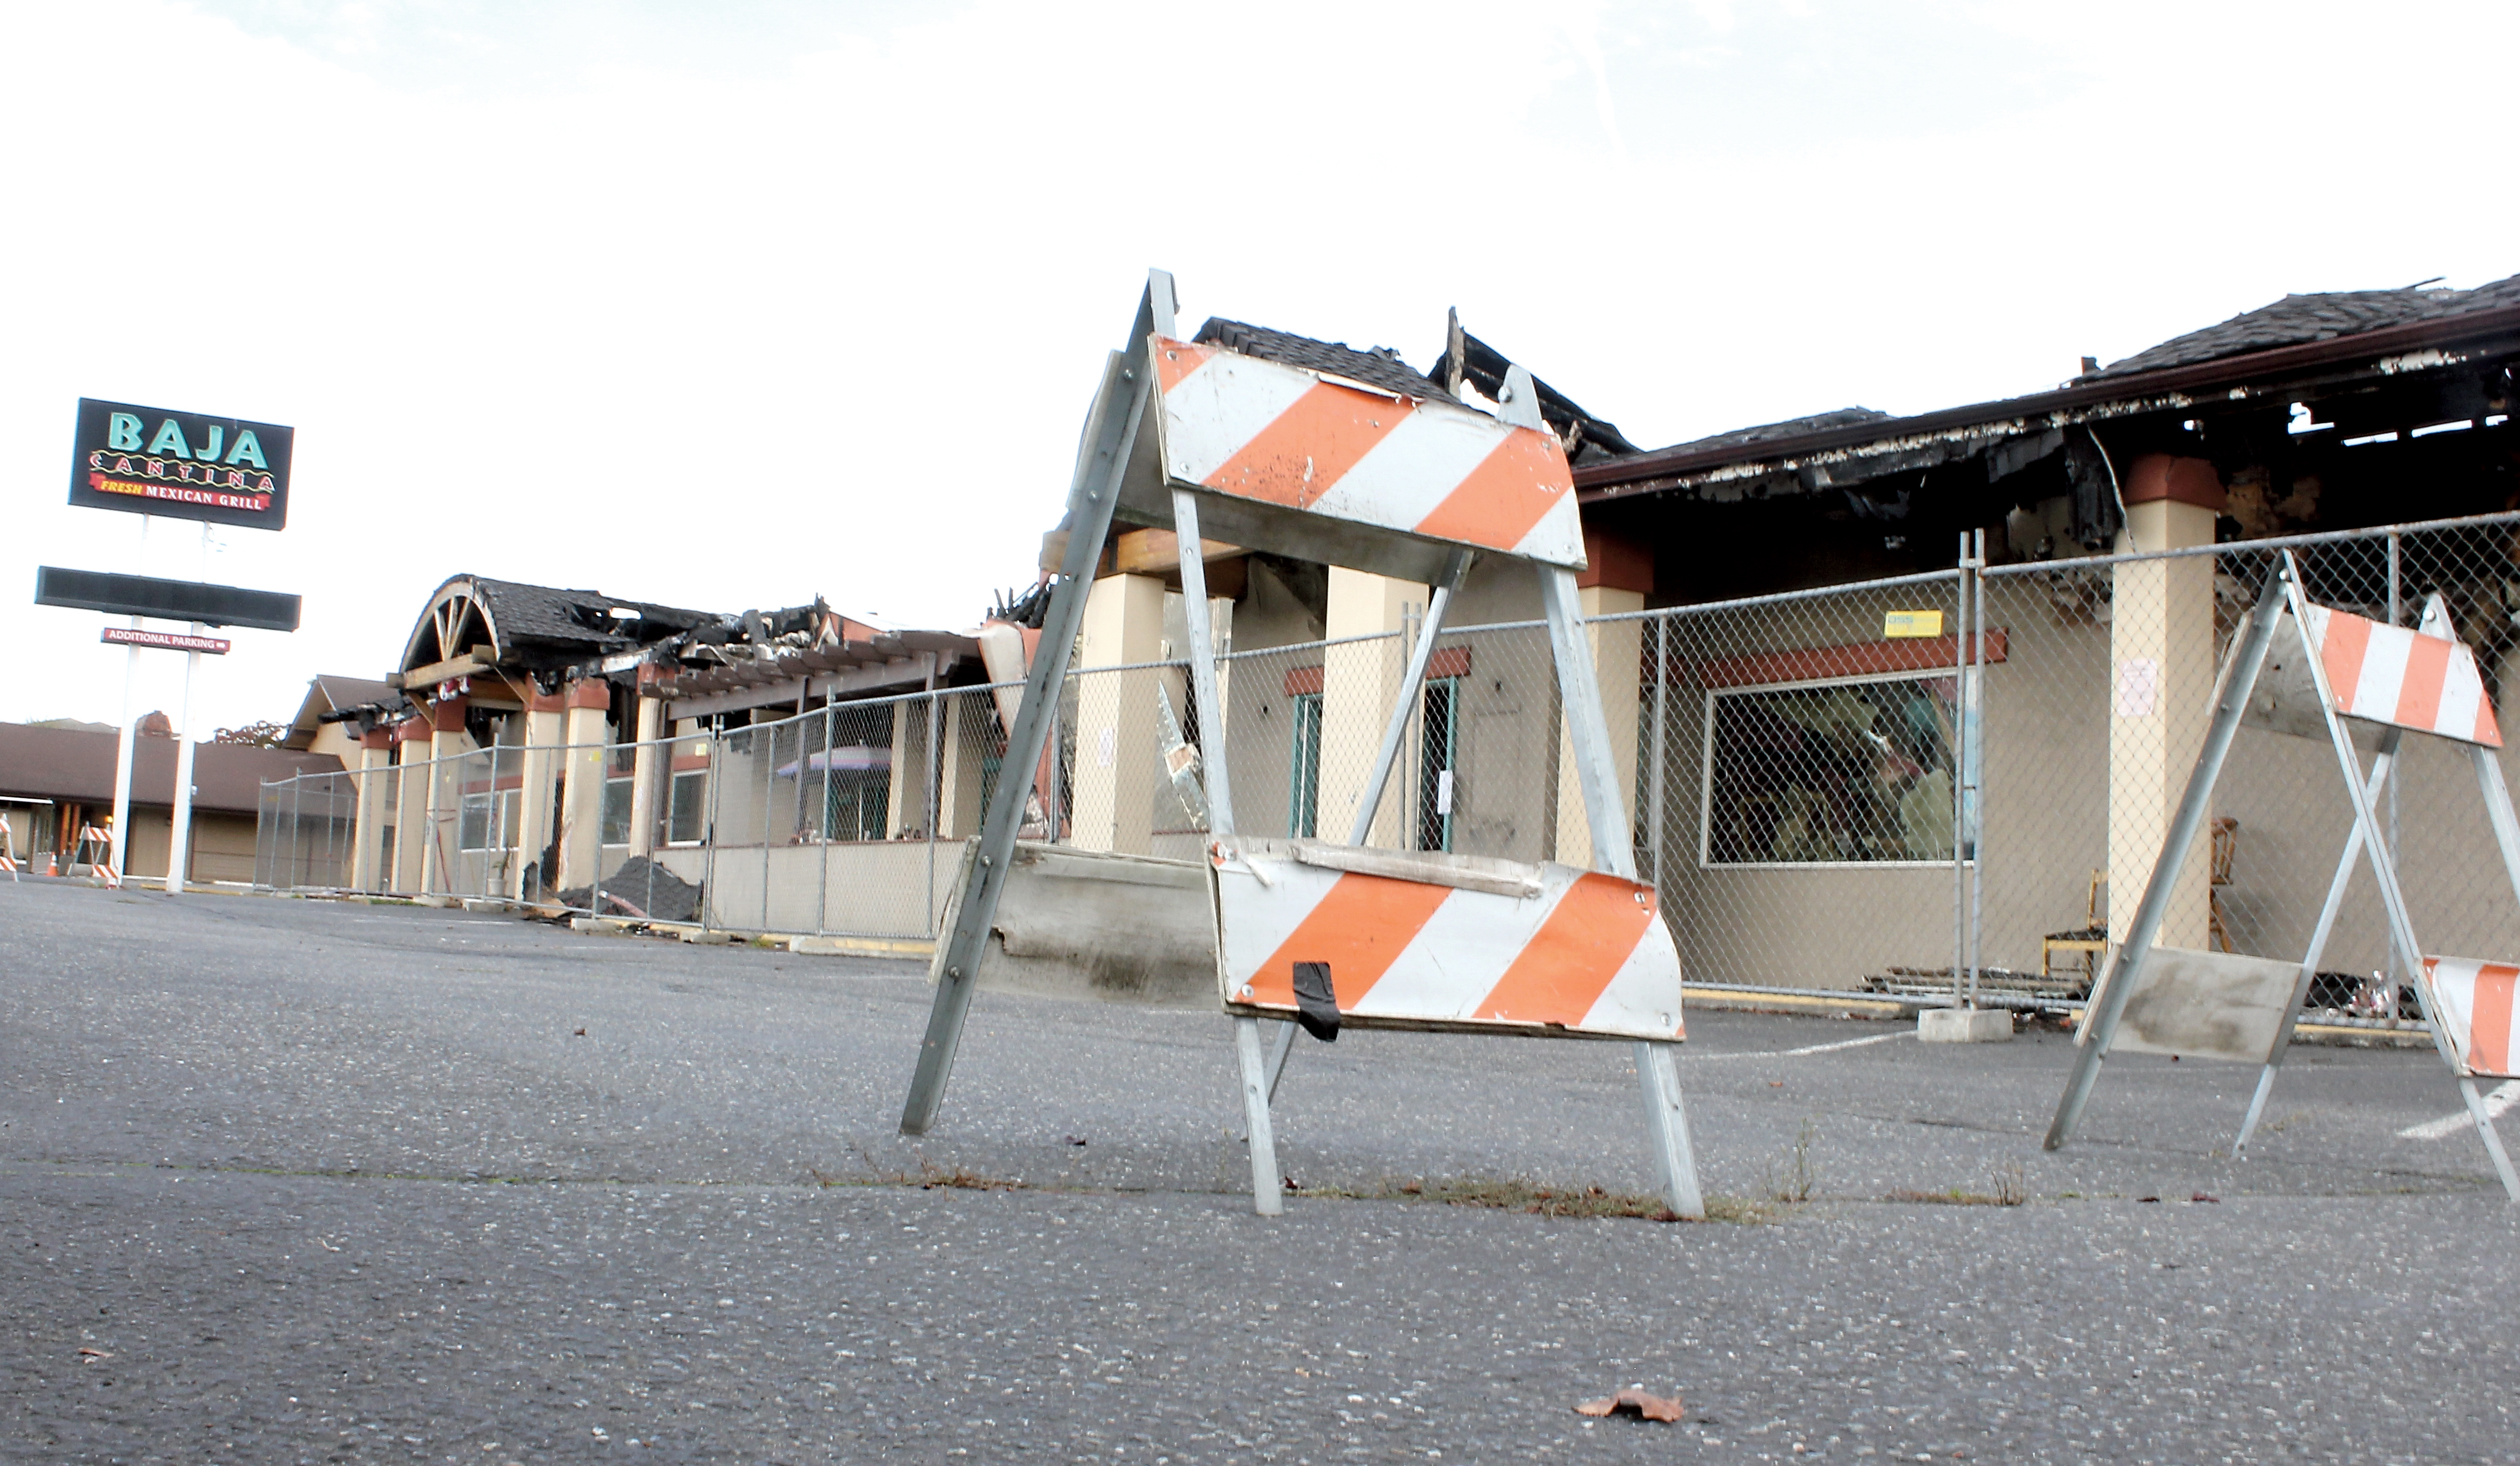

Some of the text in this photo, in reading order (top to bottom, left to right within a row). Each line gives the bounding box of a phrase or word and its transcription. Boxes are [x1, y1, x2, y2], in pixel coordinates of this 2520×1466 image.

[109, 412, 269, 469] BAJA
[89, 454, 276, 492] CANTINA
[100, 480, 262, 510] FRESH MEXICAN GRILL
[109, 630, 215, 649] ADDITIONAL PARKING
